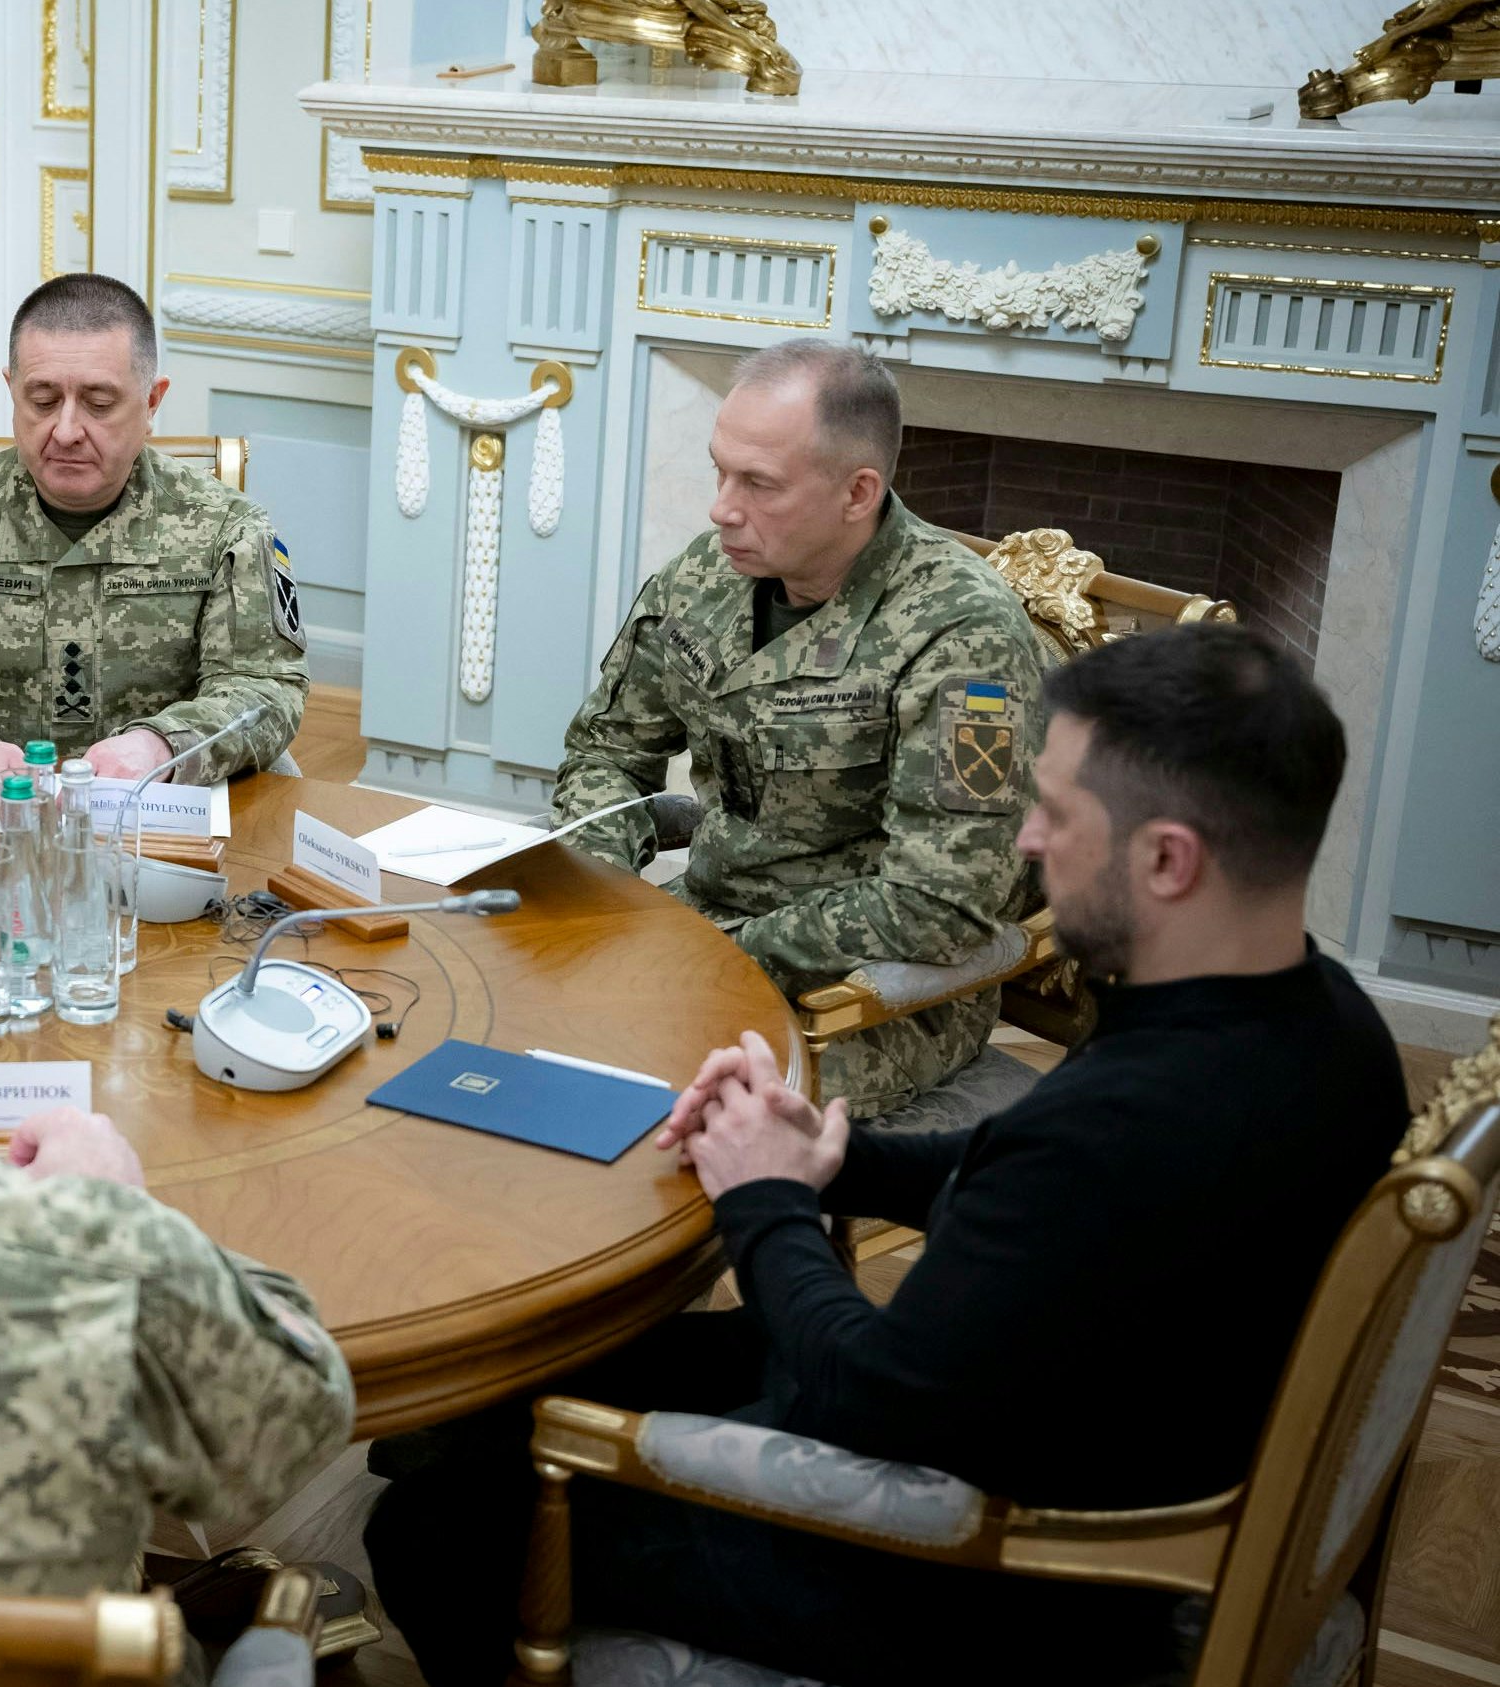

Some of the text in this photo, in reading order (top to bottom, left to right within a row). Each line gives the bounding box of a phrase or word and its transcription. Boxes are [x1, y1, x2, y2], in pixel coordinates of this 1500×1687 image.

[107, 577, 210, 589] ЗБРОЙНІ СИЛИ УКРАЇНИ
[298, 832, 334, 859] Oleksandr
